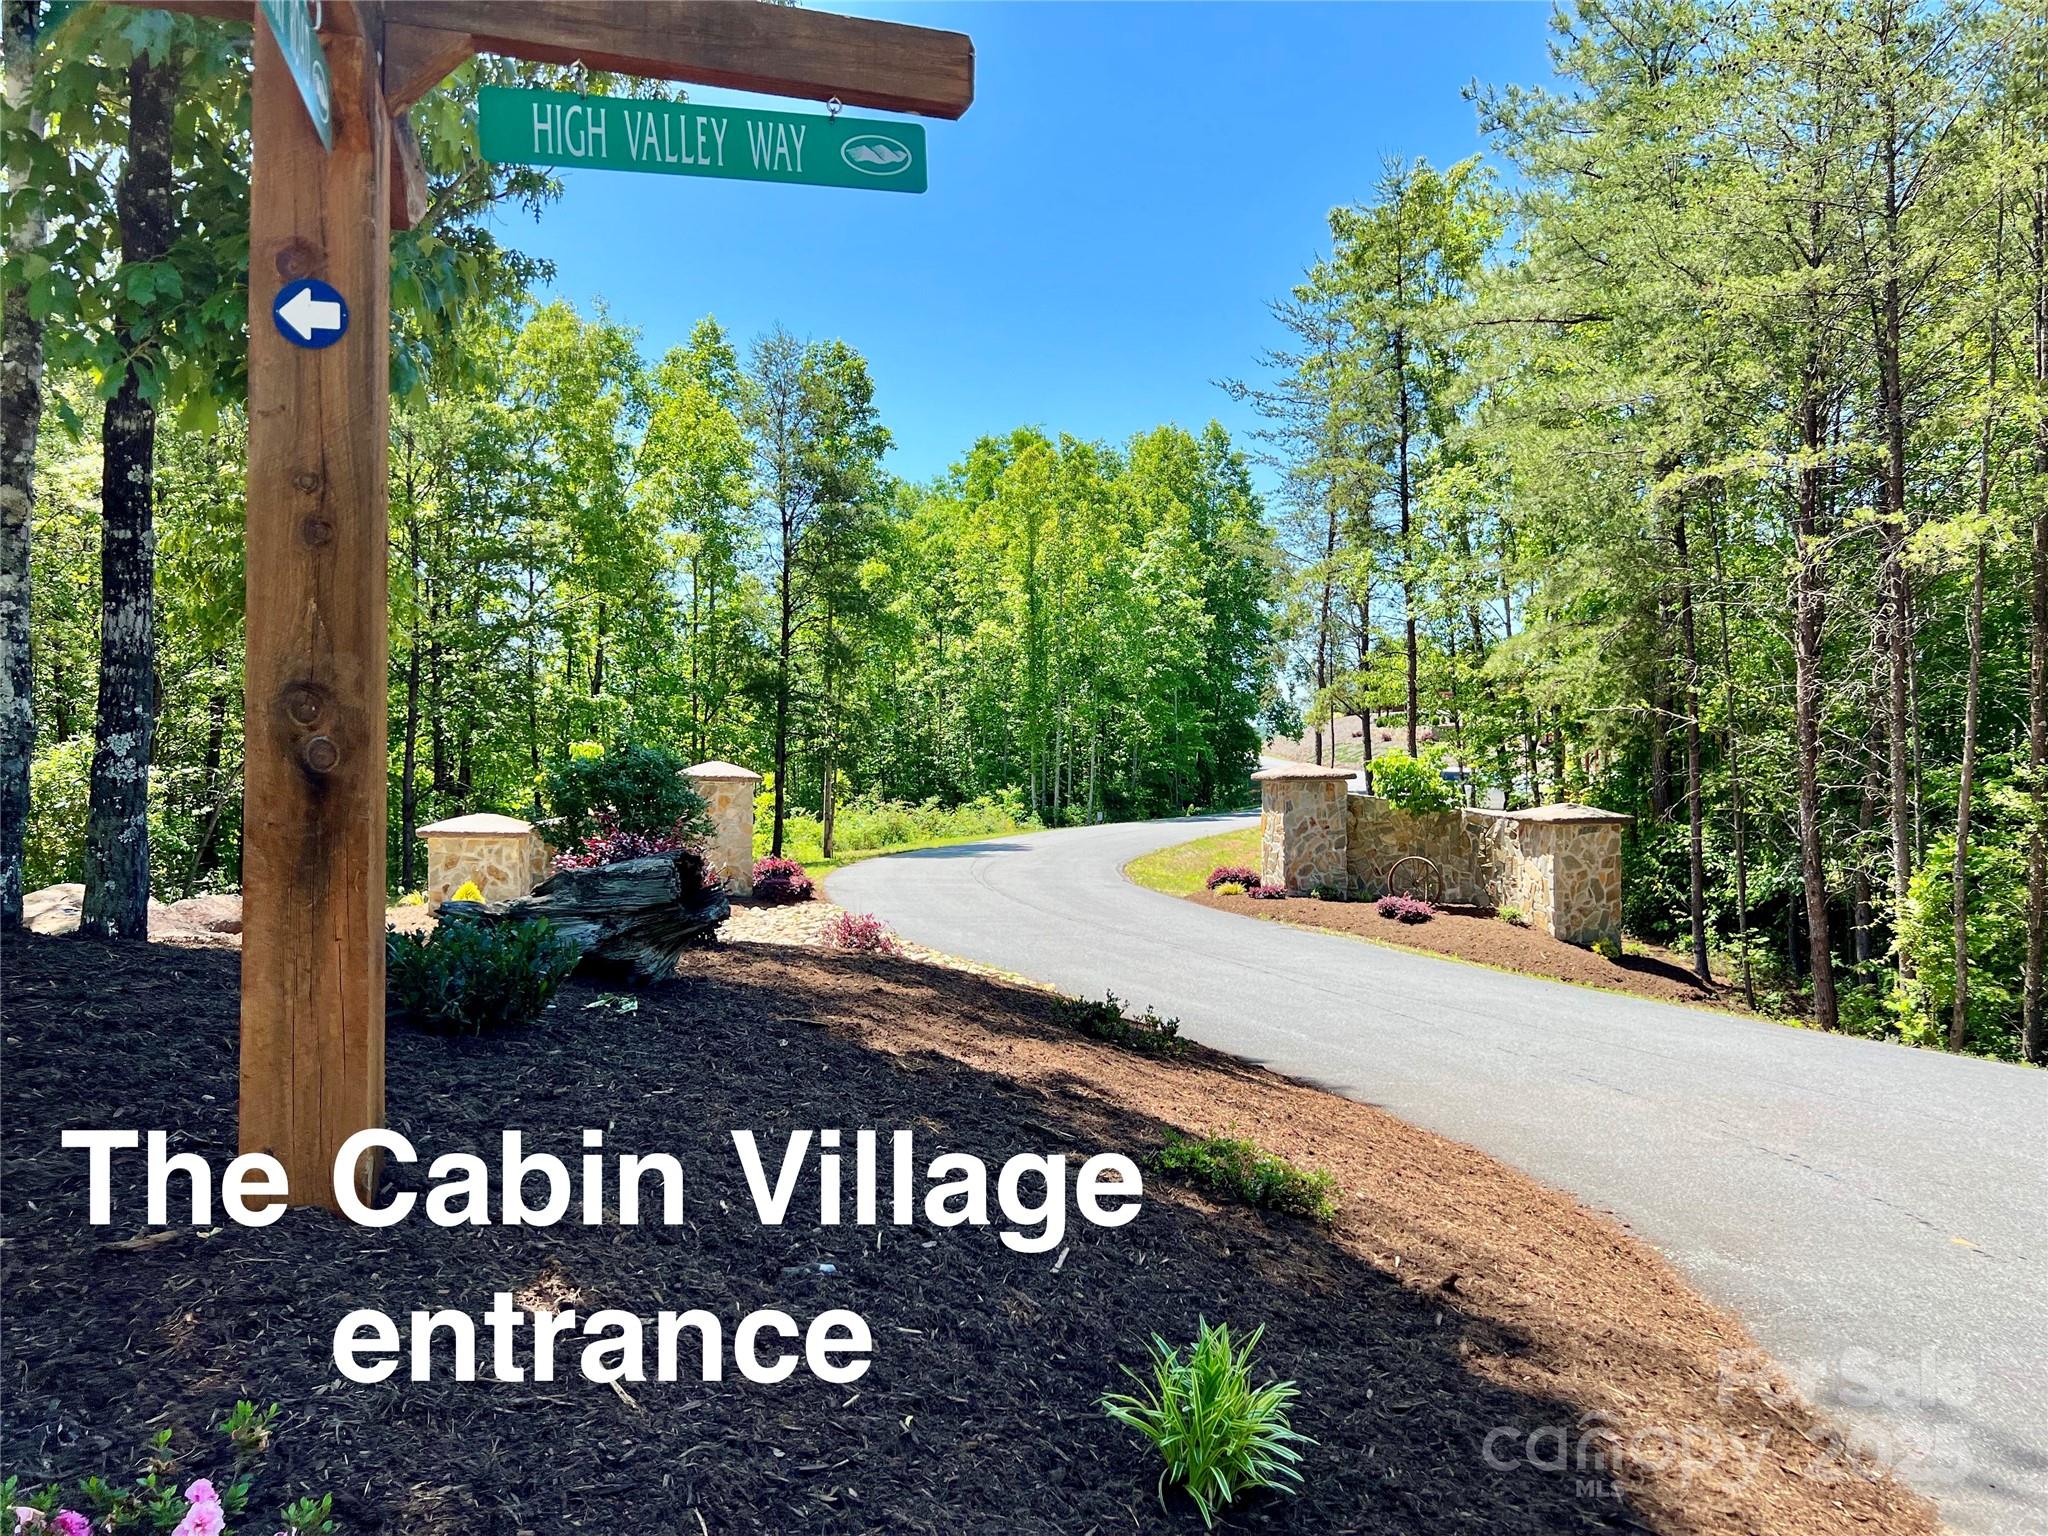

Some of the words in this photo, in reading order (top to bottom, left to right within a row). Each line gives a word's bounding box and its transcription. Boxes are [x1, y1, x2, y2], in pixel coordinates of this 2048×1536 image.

[532, 102, 608, 158] HIGH
[623, 110, 728, 166] VALLEY
[746, 120, 807, 172] WAY
